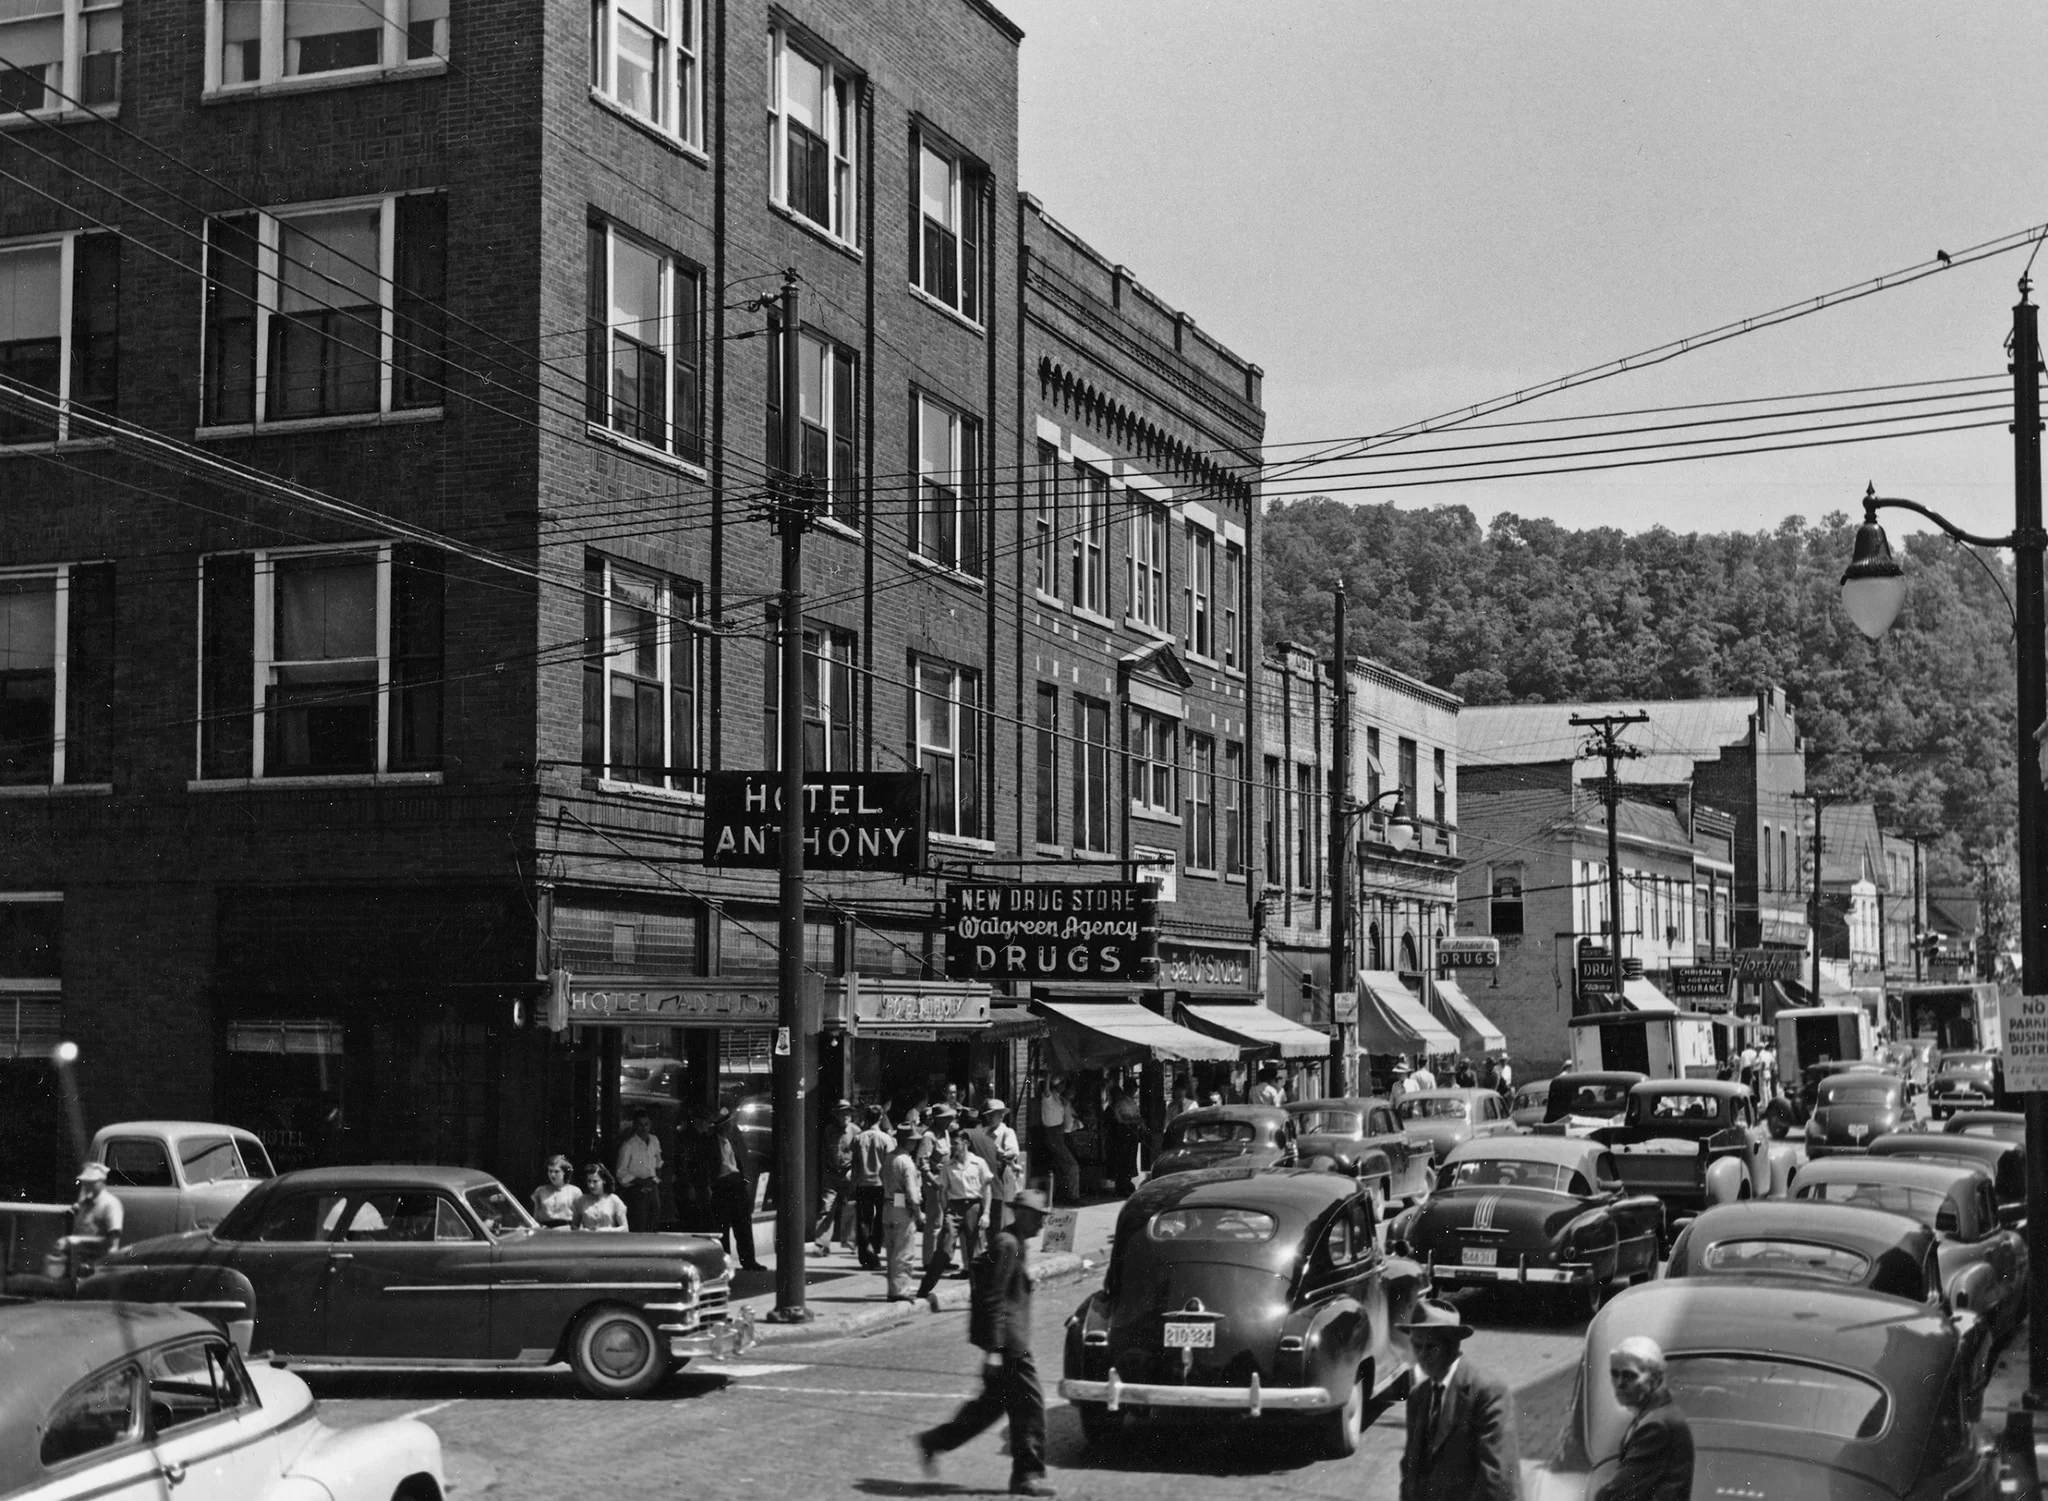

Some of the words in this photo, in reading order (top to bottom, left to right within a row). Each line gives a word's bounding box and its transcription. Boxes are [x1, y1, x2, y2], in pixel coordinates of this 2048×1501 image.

[962, 889, 1000, 911] NEW
[1010, 889, 1063, 911] DRUG
[1072, 889, 1135, 911] STORE
[958, 915, 1059, 940] Walgreen
[1060, 916, 1139, 941] Agency
[976, 945, 1121, 972] DRUGS
[1441, 952, 1495, 965] DRUGS
[1735, 952, 1797, 975] Florsheim
[1583, 963, 1613, 977] DRU
[1679, 968, 1723, 976] CHRISMAN
[1677, 983, 1725, 993] INSURANCE
[572, 992, 659, 1012] HOTEL
[677, 991, 777, 1013] ANTHON
[2022, 1002, 2045, 1014] NO
[2009, 1018, 2048, 1030] PARKI
